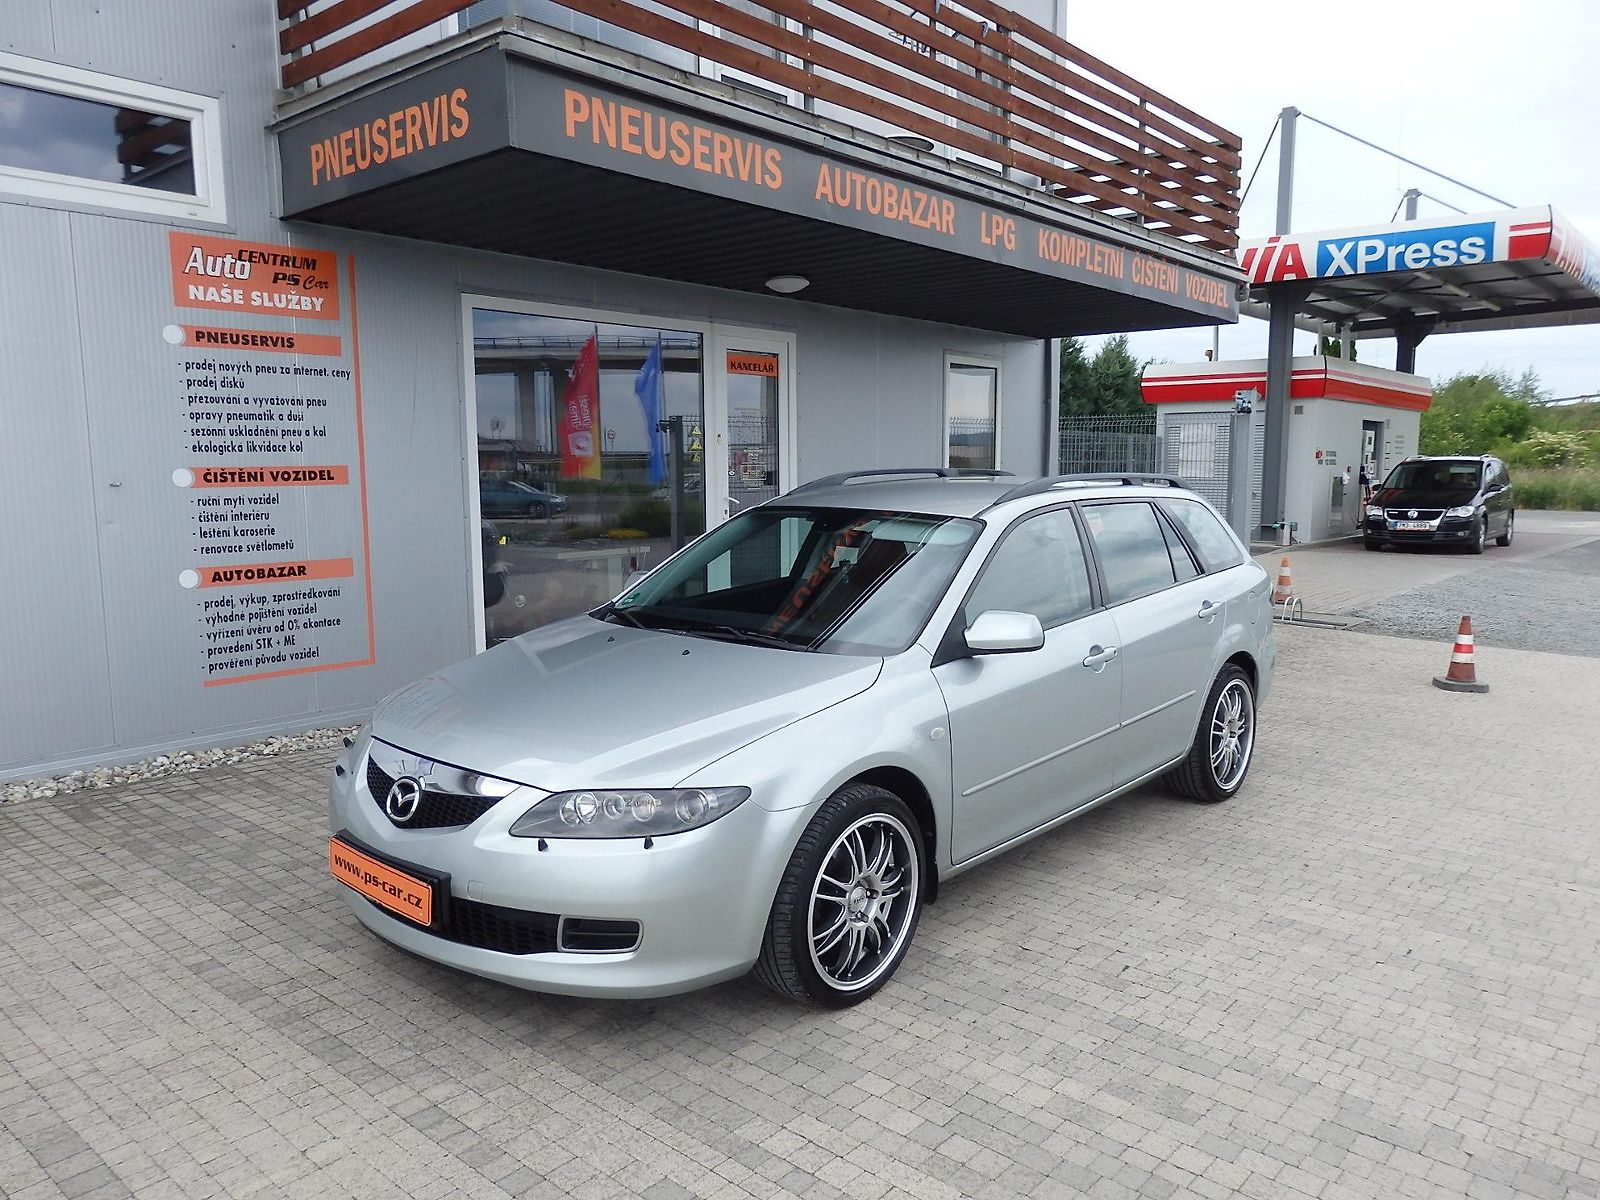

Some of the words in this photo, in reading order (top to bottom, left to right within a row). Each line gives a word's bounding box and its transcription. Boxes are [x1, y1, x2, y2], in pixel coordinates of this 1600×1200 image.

[311, 87, 470, 186] PNEUSERVIS
[564, 89, 784, 191] PNEUSERVIS
[815, 163, 956, 236] AUTOBAZAR
[980, 211, 1016, 251] LPG
[1038, 228, 1126, 279] KOMPLETNÍ
[1185, 272, 1229, 308] VOZIDEL
[183, 246, 252, 280] Auto
[238, 249, 317, 271] CENTRUM
[1321, 236, 1486, 277] XPress
[272, 272, 301, 286] PS
[303, 275, 329, 290] Car
[188, 283, 244, 305] NAŠE
[251, 290, 324, 312] SLUŽBY
[195, 330, 295, 349] PNEUSERVIS
[185, 359, 216, 374] prodej
[219, 361, 252, 375] nových
[255, 365, 277, 376] pneu
[280, 366, 290, 375] za
[293, 364, 330, 377] internet.
[332, 369, 351, 380] ceny
[730, 360, 774, 373] KANCELÁŘ
[187, 376, 217, 391] prodej
[188, 394, 241, 407] přezouvání
[243, 397, 249, 405] a
[306, 398, 327, 409] pneu
[190, 412, 223, 424] opravy
[227, 410, 275, 424] pneumatik
[278, 413, 284, 421] a
[281, 428, 302, 440] pneu
[304, 429, 310, 437] a
[312, 425, 327, 437] kol
[192, 441, 244, 456] ekologická
[246, 440, 287, 453] likvidace
[289, 441, 304, 453] kol
[203, 468, 265, 483] ČIŠTĚNÍ
[269, 469, 335, 482] VOZIDEL
[197, 496, 221, 507] ruční
[247, 493, 280, 505] vozidel
[198, 510, 228, 523] čištění
[231, 510, 269, 522] interiéru
[200, 526, 231, 539] leštění
[233, 524, 276, 538] karoserie
[201, 544, 243, 555] renovace
[246, 540, 294, 553] světlometů
[211, 565, 307, 583] AUTOBAZAR
[272, 587, 341, 605] zprostředkování
[205, 611, 246, 628] výhodné
[248, 607, 285, 623] pojištění
[287, 602, 318, 616] vozidel
[274, 621, 285, 633] od
[287, 619, 300, 631] 0%
[303, 618, 341, 630] akontace
[207, 641, 254, 659] provedení
[256, 637, 274, 650] STK
[284, 634, 296, 647] ME
[255, 651, 287, 668] původu
[289, 646, 320, 661] vozidel
[334, 855, 423, 909] www.ps-car.cz
